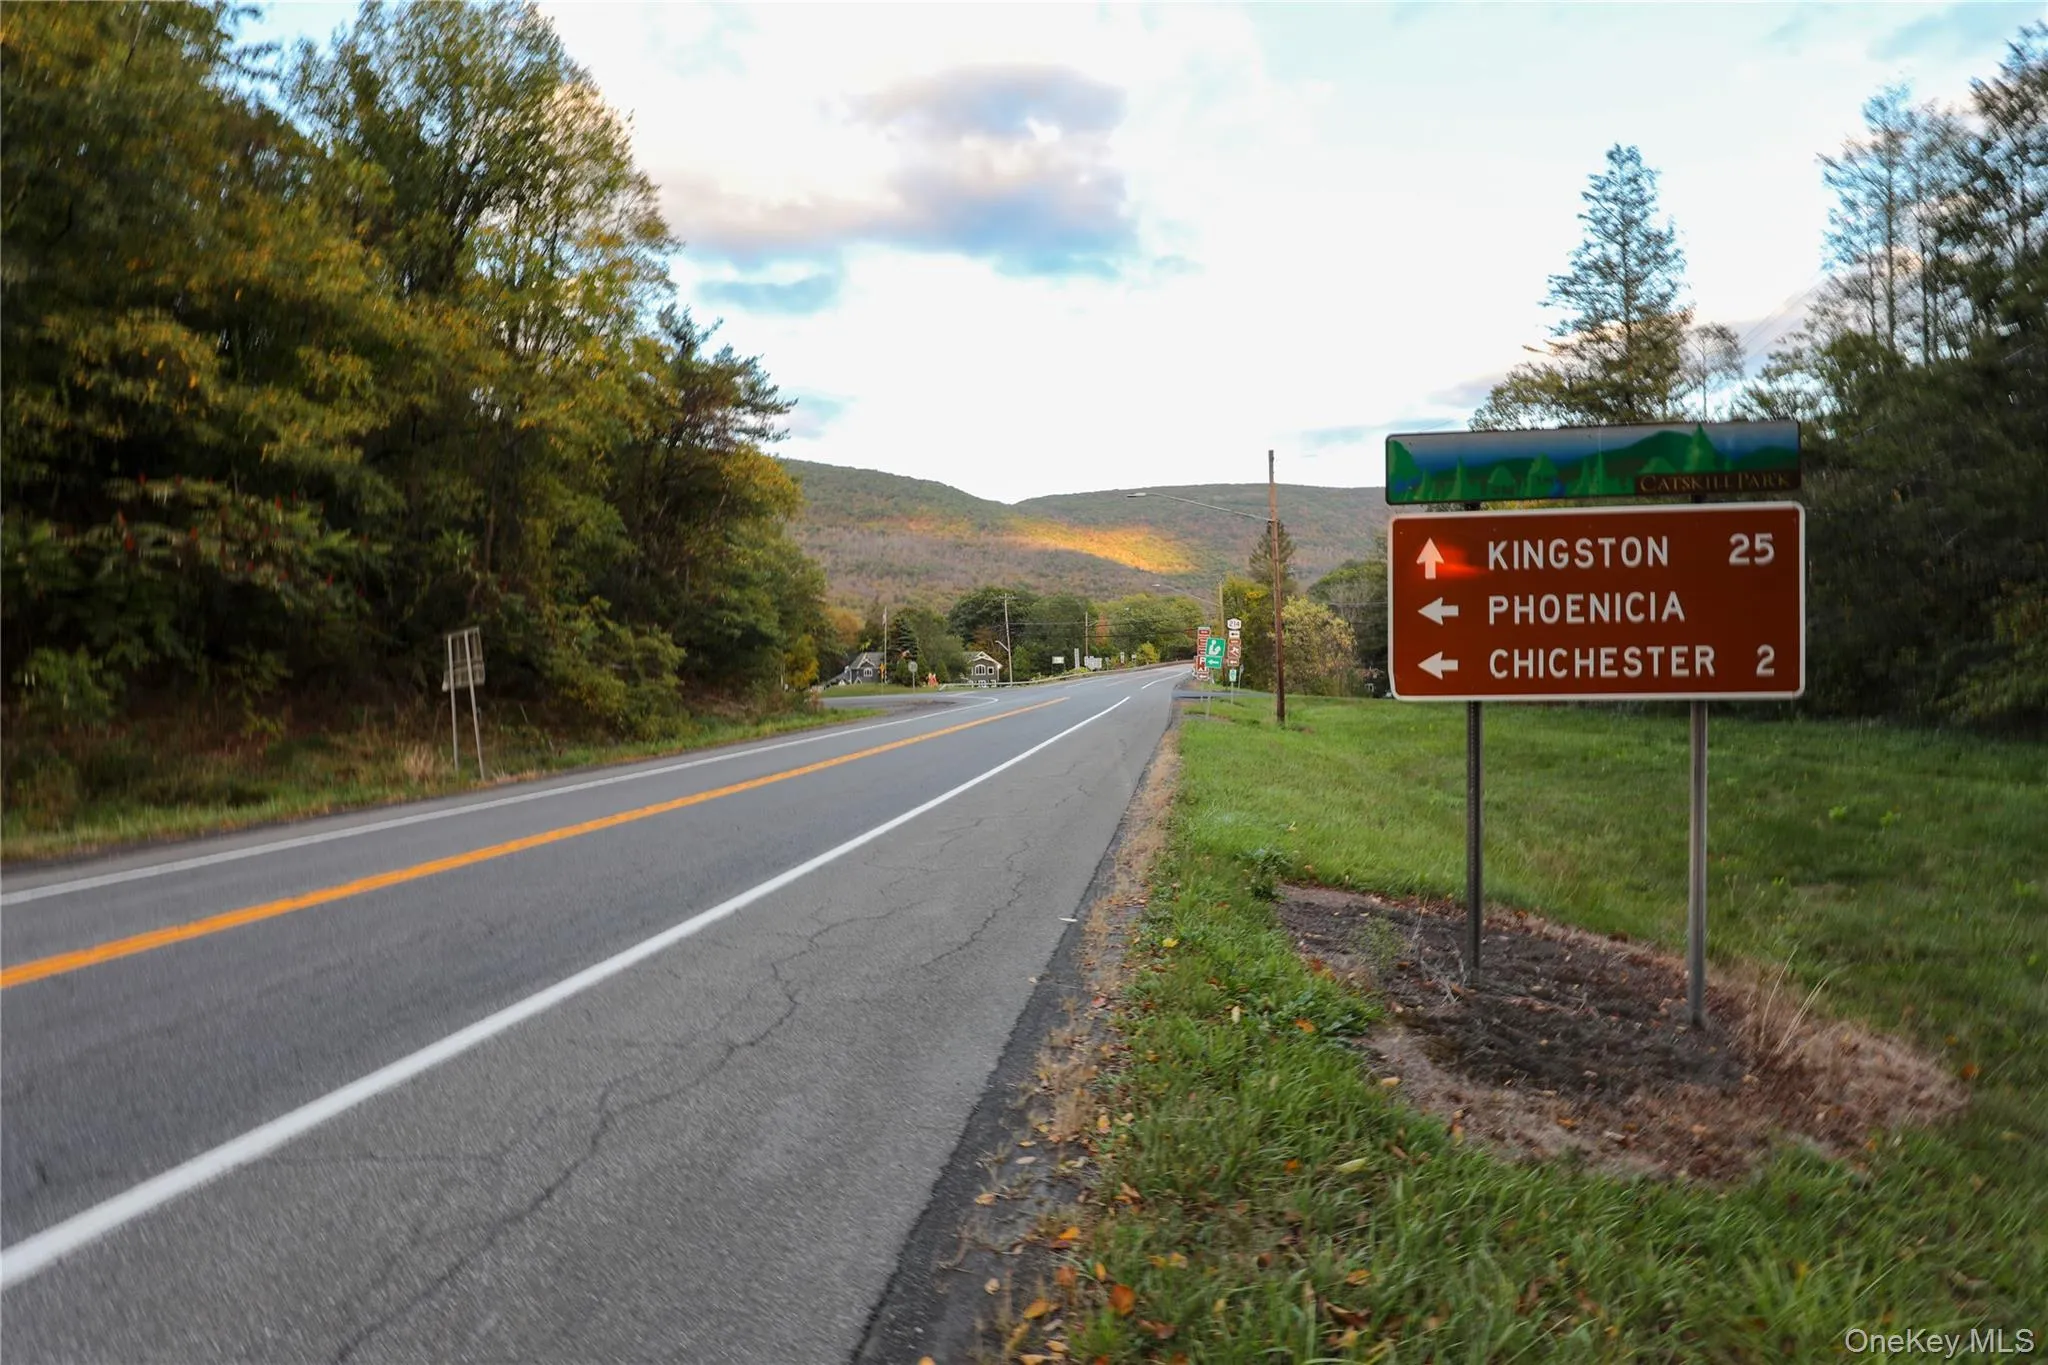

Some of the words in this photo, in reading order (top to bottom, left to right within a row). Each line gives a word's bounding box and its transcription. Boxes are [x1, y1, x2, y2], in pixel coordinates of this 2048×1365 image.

[1488, 535, 1668, 571] KINGSTON
[1728, 533, 1775, 564] 25
[1488, 591, 1685, 626] PHOENICIA
[1489, 645, 1715, 679] CHICHESTER
[1756, 644, 1775, 676] 2
